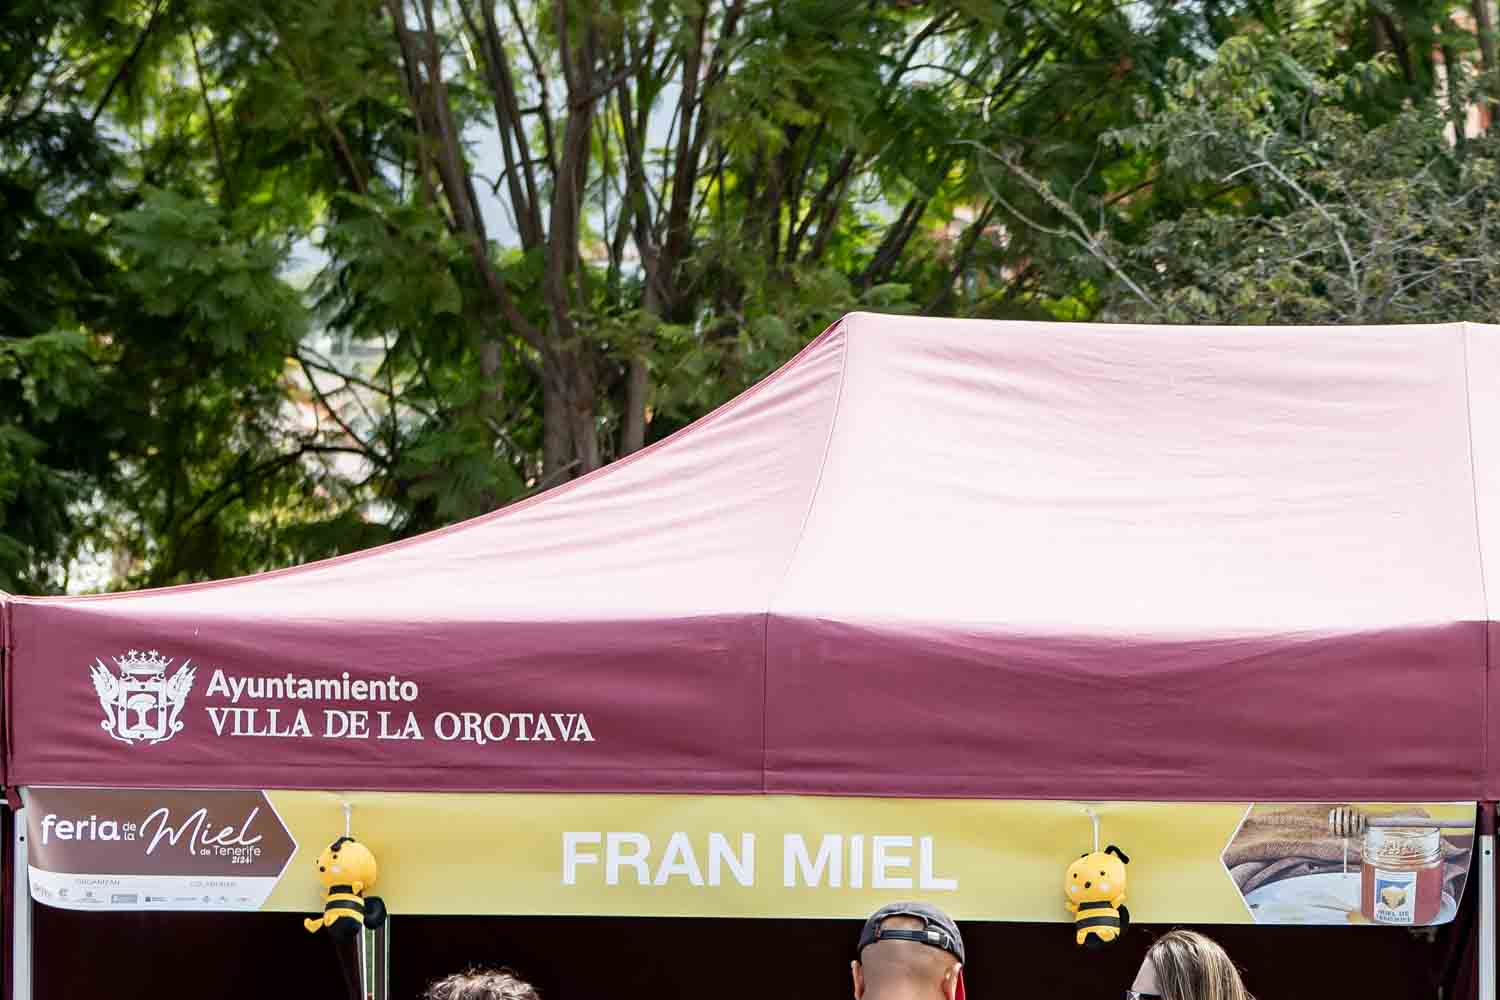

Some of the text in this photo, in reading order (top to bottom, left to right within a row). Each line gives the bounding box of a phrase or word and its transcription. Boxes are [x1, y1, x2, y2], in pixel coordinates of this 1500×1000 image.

[206, 669, 418, 702] Ayuntamiento
[205, 708, 595, 744] VILLA DE LA OROTAVA
[41, 807, 262, 855] feria de la Miel
[212, 845, 262, 860] Tenerife
[560, 831, 959, 891] FRAN MIEL
